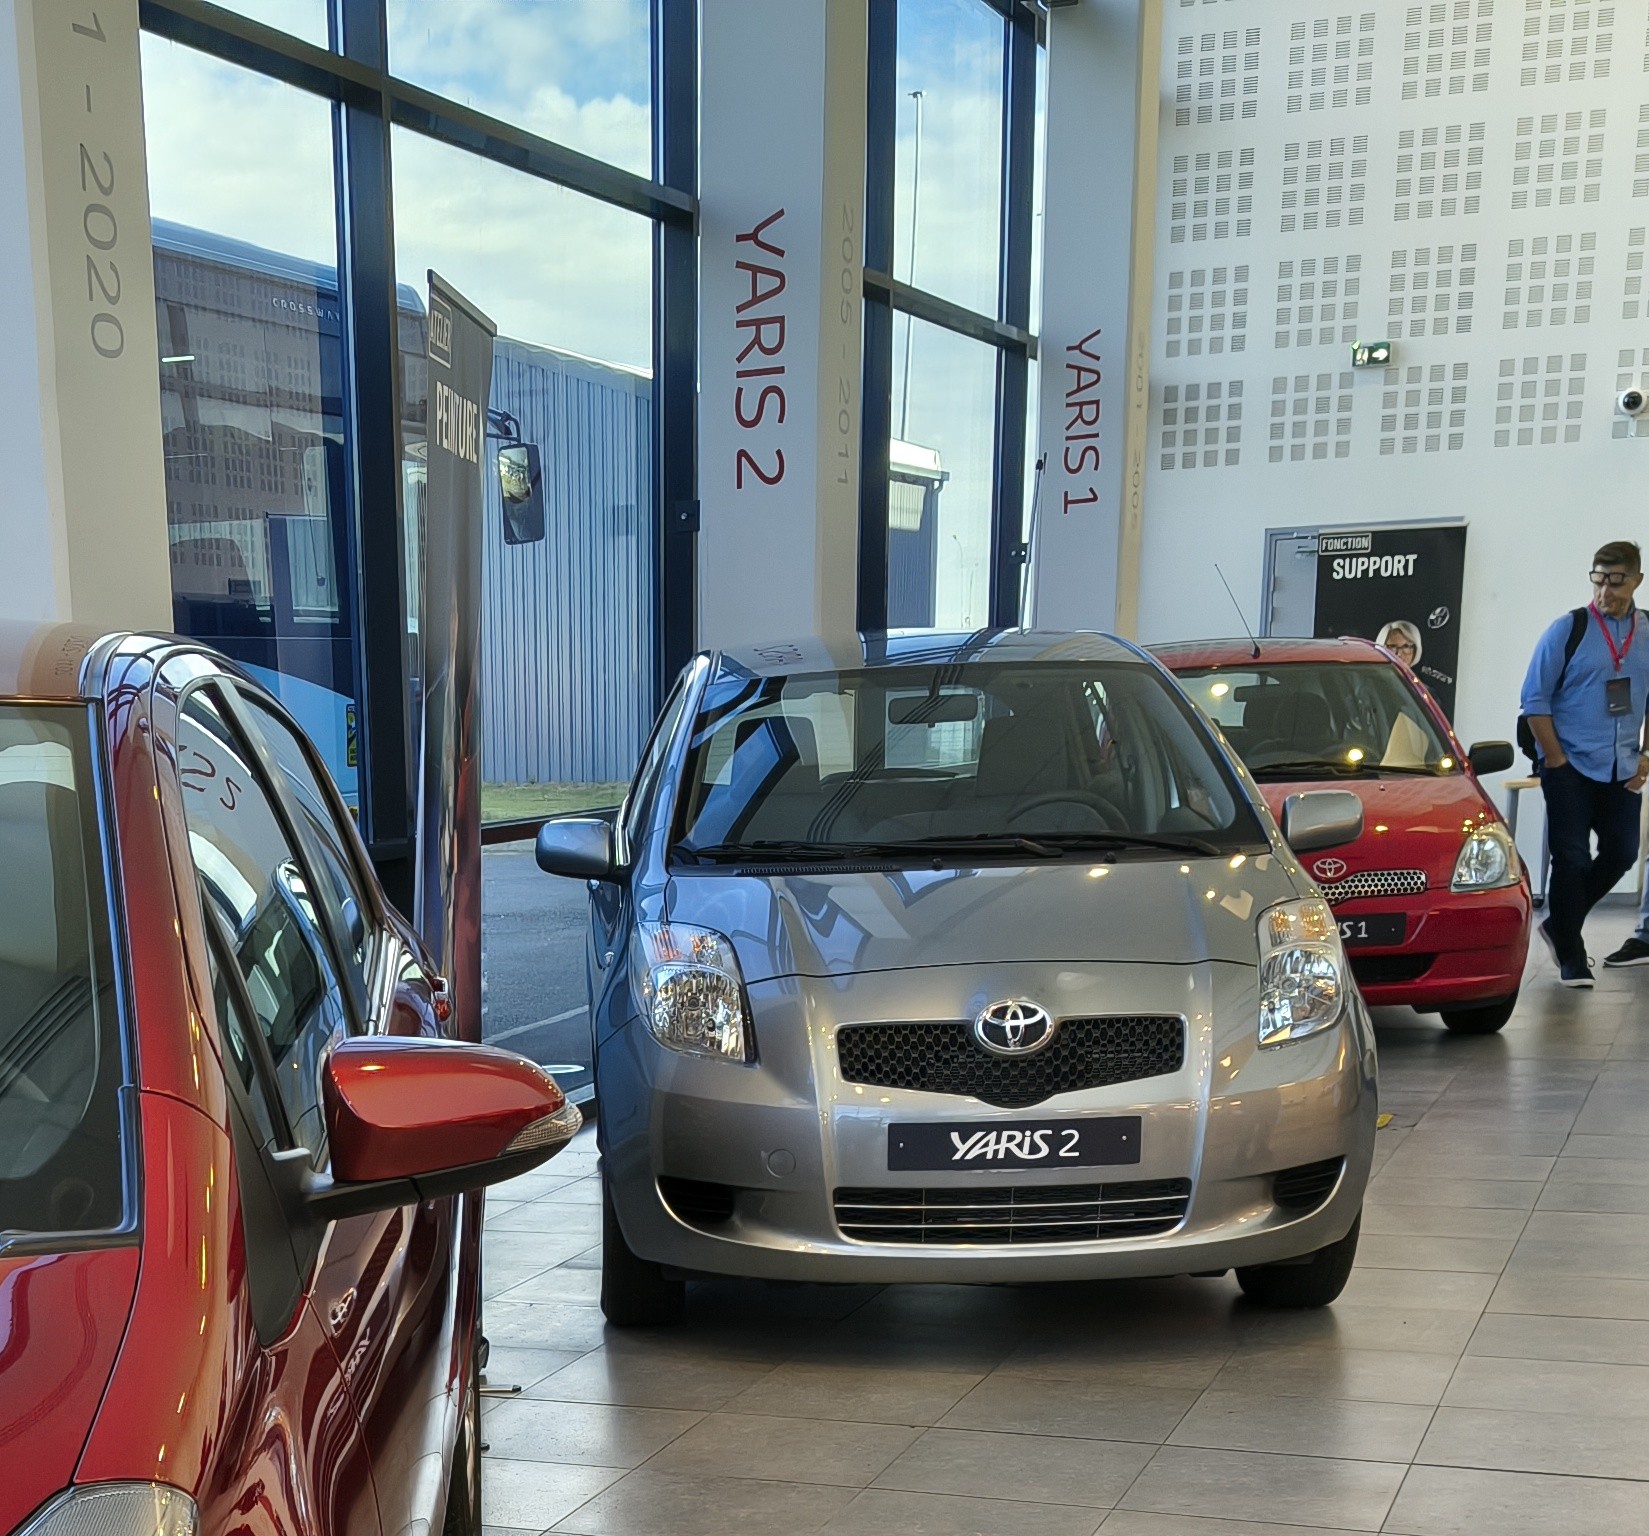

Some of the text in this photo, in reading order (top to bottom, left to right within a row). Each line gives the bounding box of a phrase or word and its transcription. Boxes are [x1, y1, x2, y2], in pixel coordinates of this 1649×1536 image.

[79, 142, 125, 359] 2020
[734, 207, 787, 491] YARIS 2
[837, 377, 851, 485] 2011
[1063, 328, 1102, 516] YARIS 1
[1322, 536, 1369, 551] FONCTION
[1332, 554, 1418, 580] SUPPORT
[1357, 921, 1369, 938] 1
[1058, 1129, 1080, 1157] 2
